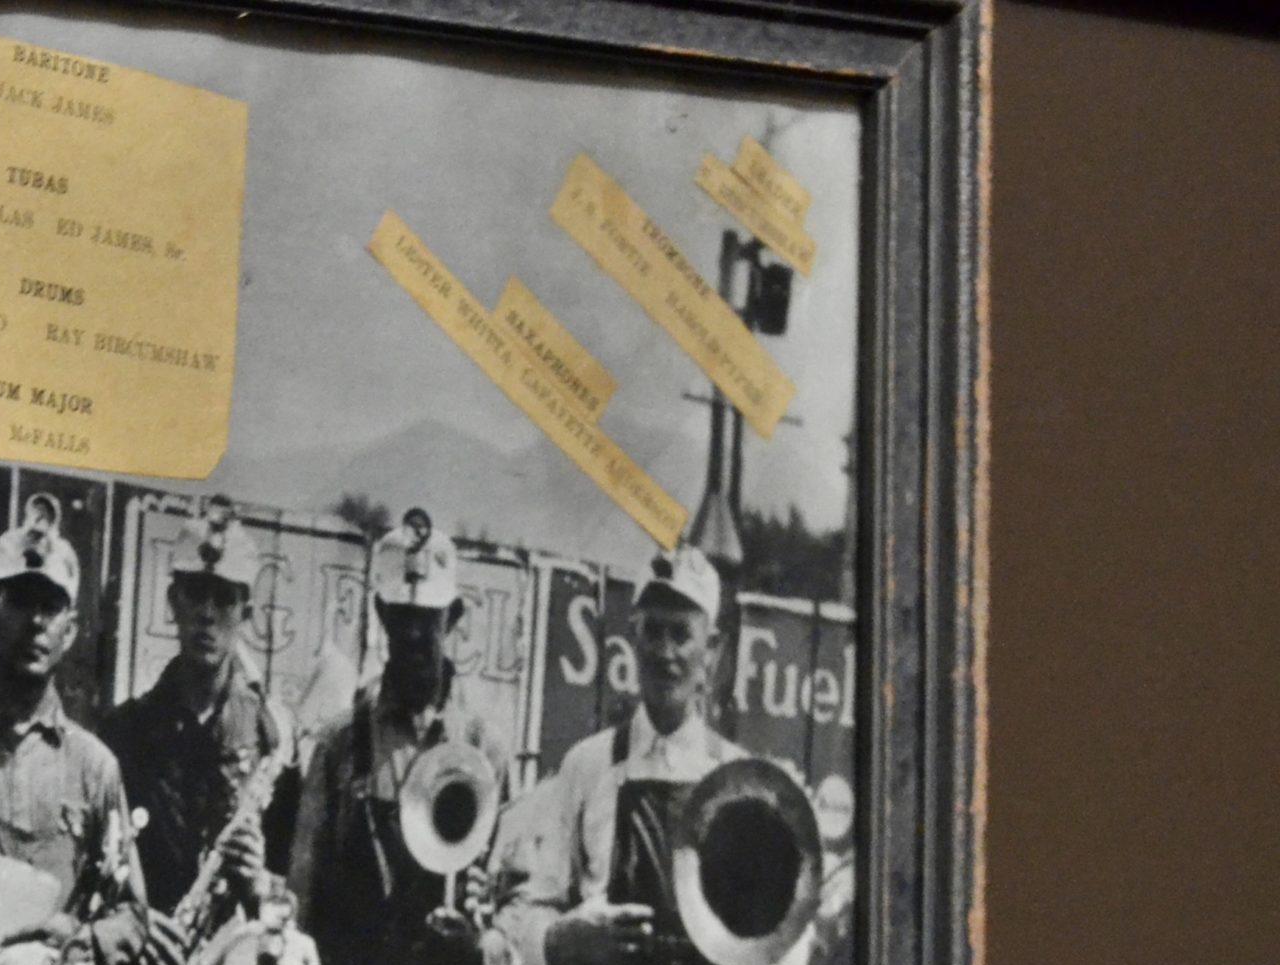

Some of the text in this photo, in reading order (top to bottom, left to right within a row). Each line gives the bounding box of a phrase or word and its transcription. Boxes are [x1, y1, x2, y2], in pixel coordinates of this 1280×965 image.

[13, 45, 110, 84] BARITONE
[52, 95, 115, 126] JAMES
[7, 166, 70, 195] TUBAS
[56, 217, 84, 238] ED
[395, 235, 452, 298] LESTER
[18, 277, 86, 307] DRUMS
[46, 323, 86, 348] RAY
[93, 330, 221, 372] BIRCUMSHAW
[505, 310, 601, 413] SAXAPHONES
[30, 387, 94, 415] MAJOR
[732, 622, 856, 728] Fuel
